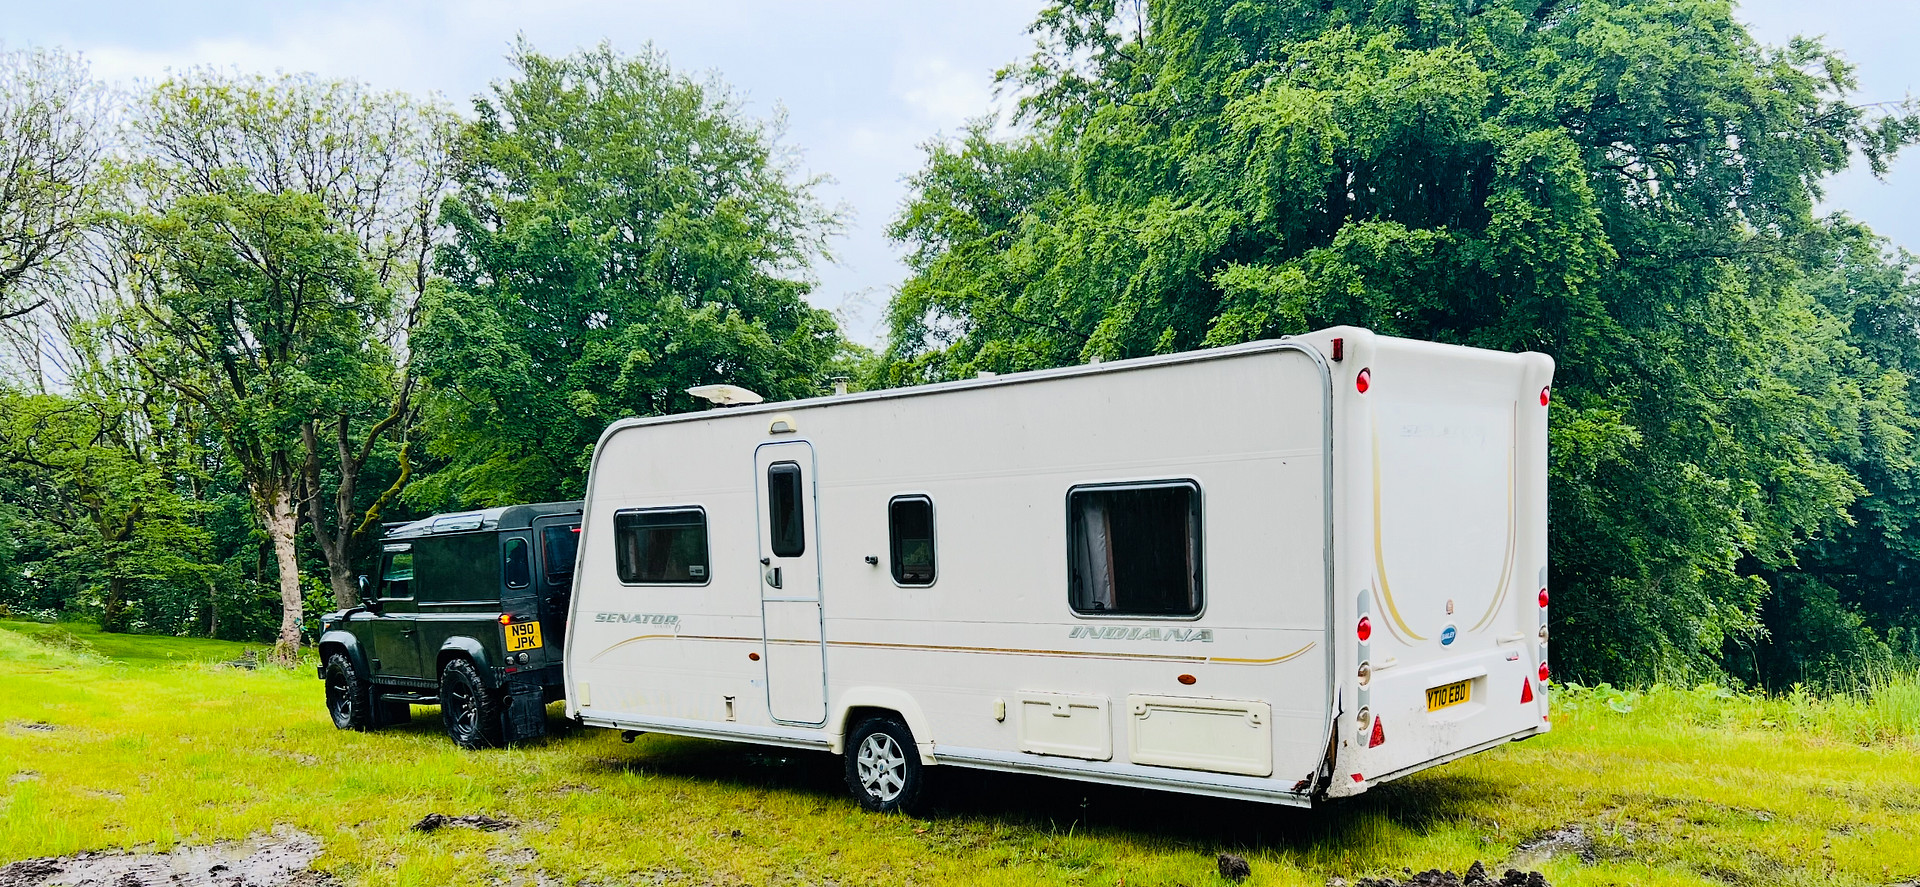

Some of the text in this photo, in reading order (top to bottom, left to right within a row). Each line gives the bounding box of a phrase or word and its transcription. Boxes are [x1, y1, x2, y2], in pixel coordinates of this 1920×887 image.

[594, 613, 679, 626] SENATOR
[511, 623, 534, 637] N90
[1068, 625, 1214, 643] INDIANA
[514, 635, 536, 649] JPK
[1427, 683, 1466, 710] YT10 EBD
